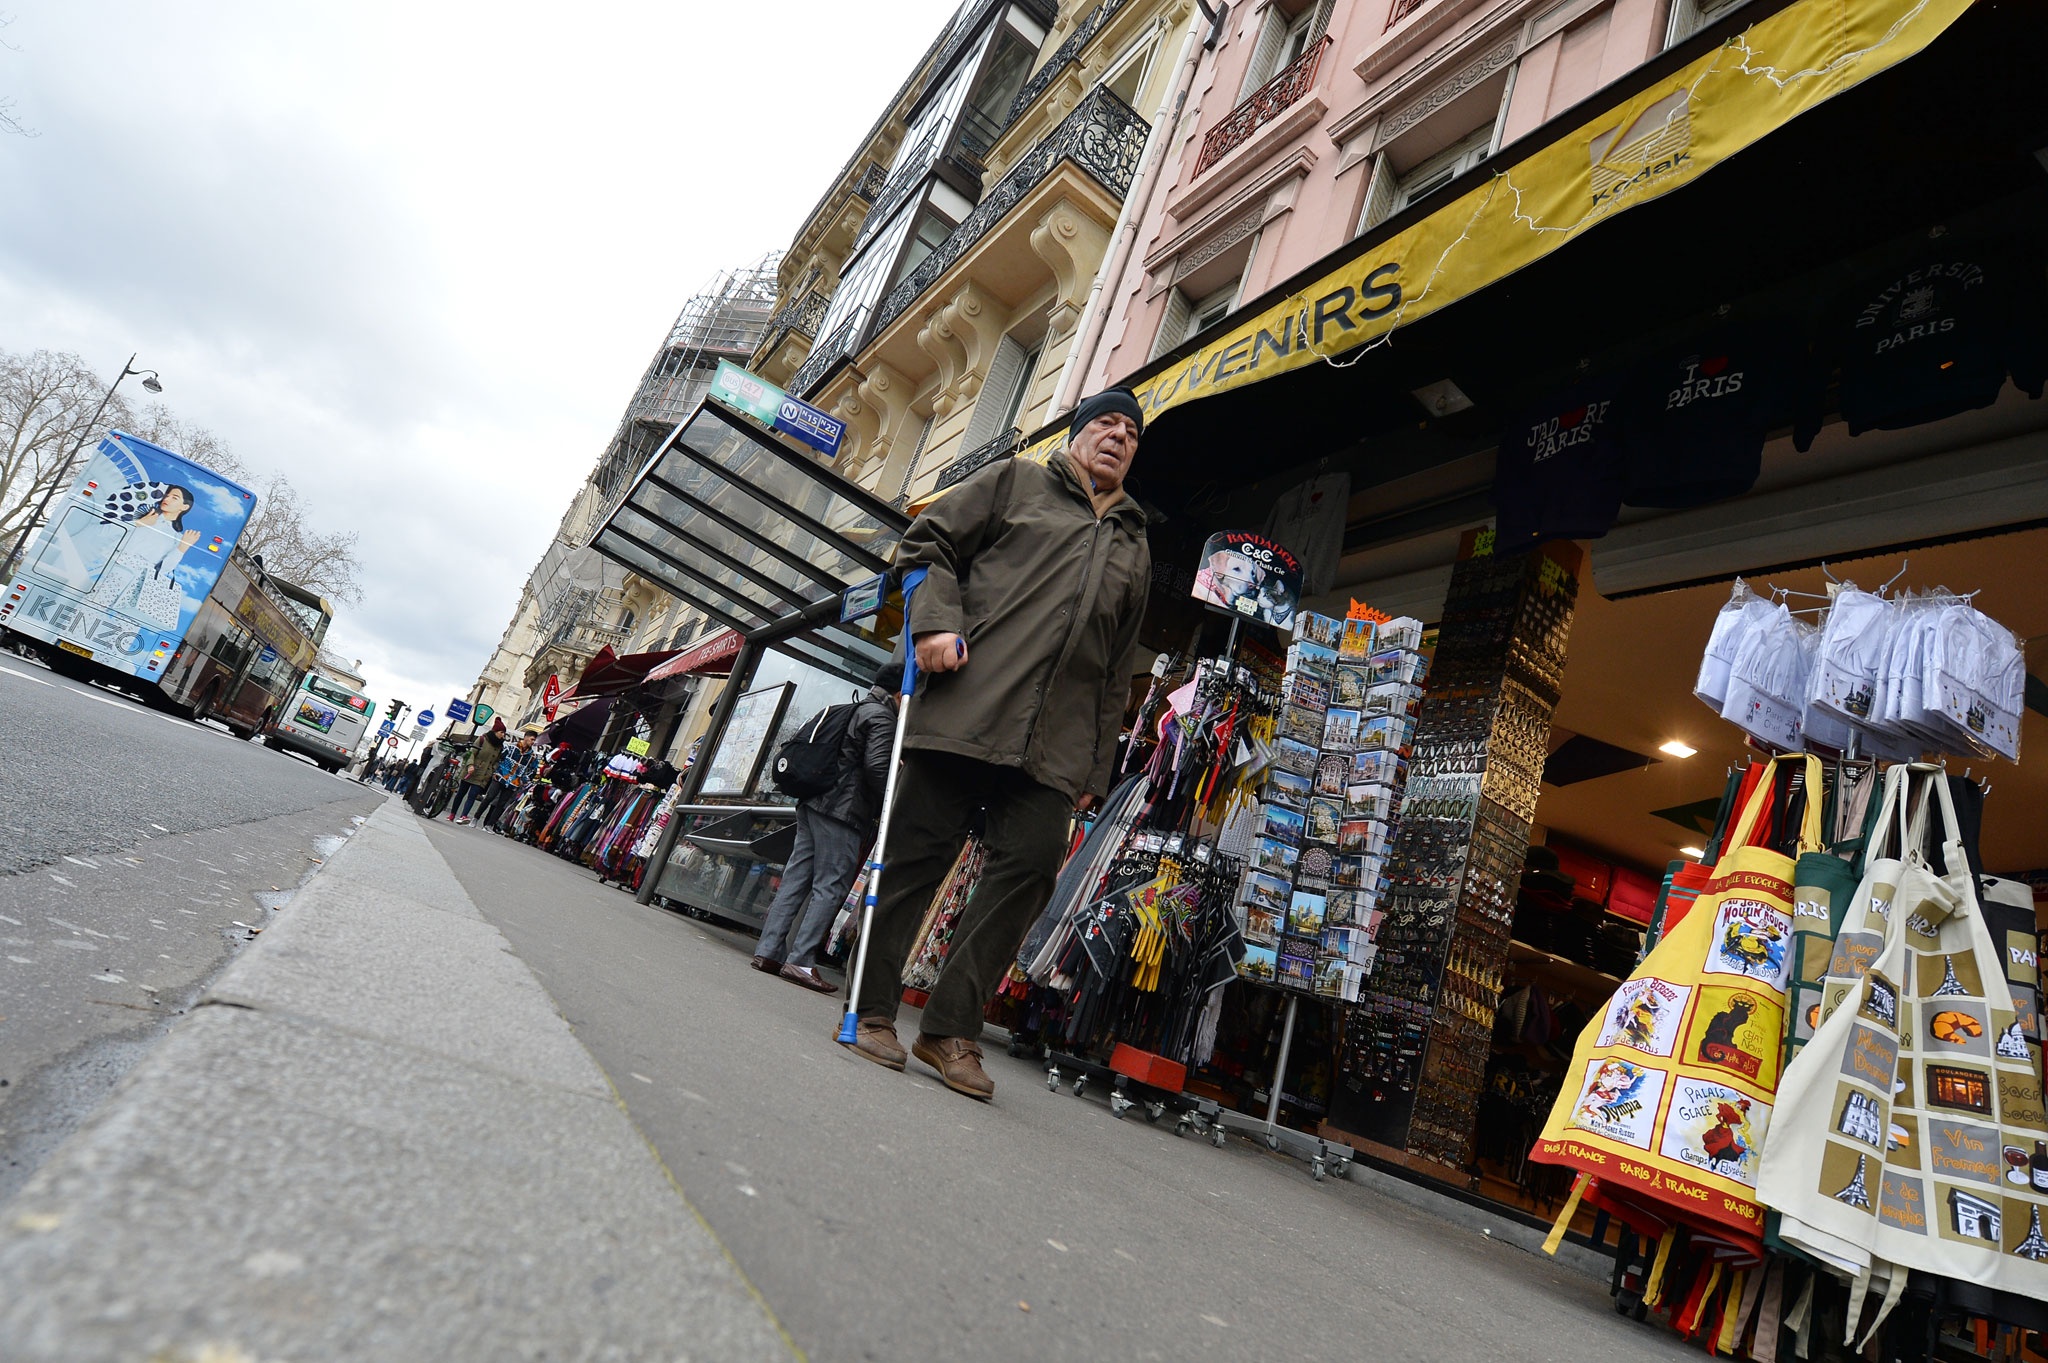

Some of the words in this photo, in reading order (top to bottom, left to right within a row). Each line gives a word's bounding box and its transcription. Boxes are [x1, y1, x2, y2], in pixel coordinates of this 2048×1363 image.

[1592, 151, 1691, 206] Kodak
[1137, 262, 1402, 411] OUVENIRS
[1874, 317, 1956, 355] PARIS
[724, 375, 738, 387] BUS
[743, 381, 761, 394] 47
[1665, 372, 1744, 411] PARIS
[1533, 424, 1593, 464] PARIS
[1241, 543, 1274, 563] C&C
[27, 595, 145, 656] KENZO
[697, 633, 738, 661] TEE-SHIRTS
[547, 684, 556, 713] TABC
[1763, 910, 1789, 936] ROUGE
[1741, 1038, 1764, 1057] NOIR
[1935, 1068, 1985, 1081] BOULANGERIE
[1684, 1086, 1725, 1104] PALAIS
[1597, 1099, 1643, 1122] Olympia
[1679, 1104, 1713, 1121] GLACE
[1943, 1126, 1984, 1152] Vin
[1680, 1147, 1708, 1165] Champs
[1568, 1144, 1607, 1164] FRANCE
[1619, 1162, 1650, 1181] PARIS
[1665, 1177, 1710, 1202] FRANCE
[1723, 1198, 1755, 1220] PARIS
[1899, 1181, 1920, 1202] de
